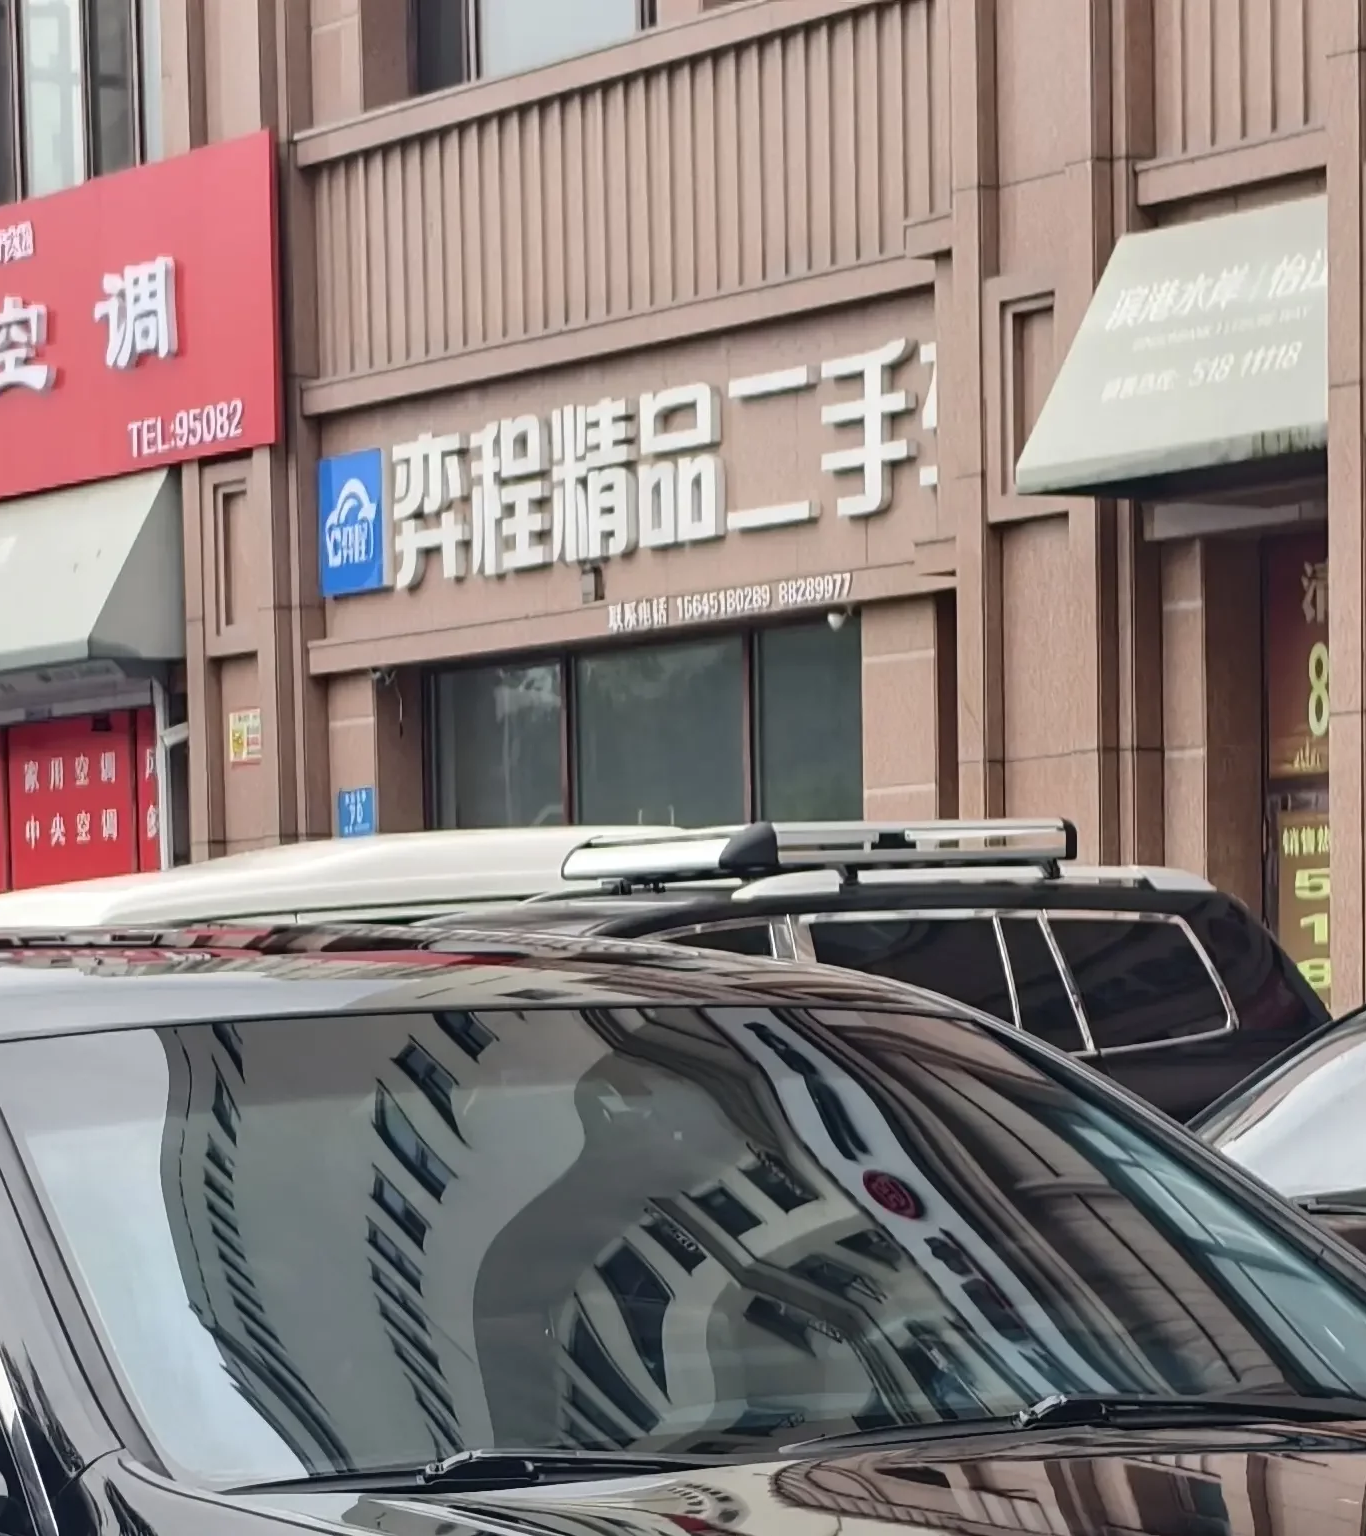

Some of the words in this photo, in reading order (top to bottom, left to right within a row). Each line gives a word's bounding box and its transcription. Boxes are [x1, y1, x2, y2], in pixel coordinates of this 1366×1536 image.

[127, 399, 243, 457] TEL:95082
[392, 338, 937, 591] 弈程精品二手
[24, 751, 116, 794] 家用空调
[25, 808, 118, 849] 中央空调
